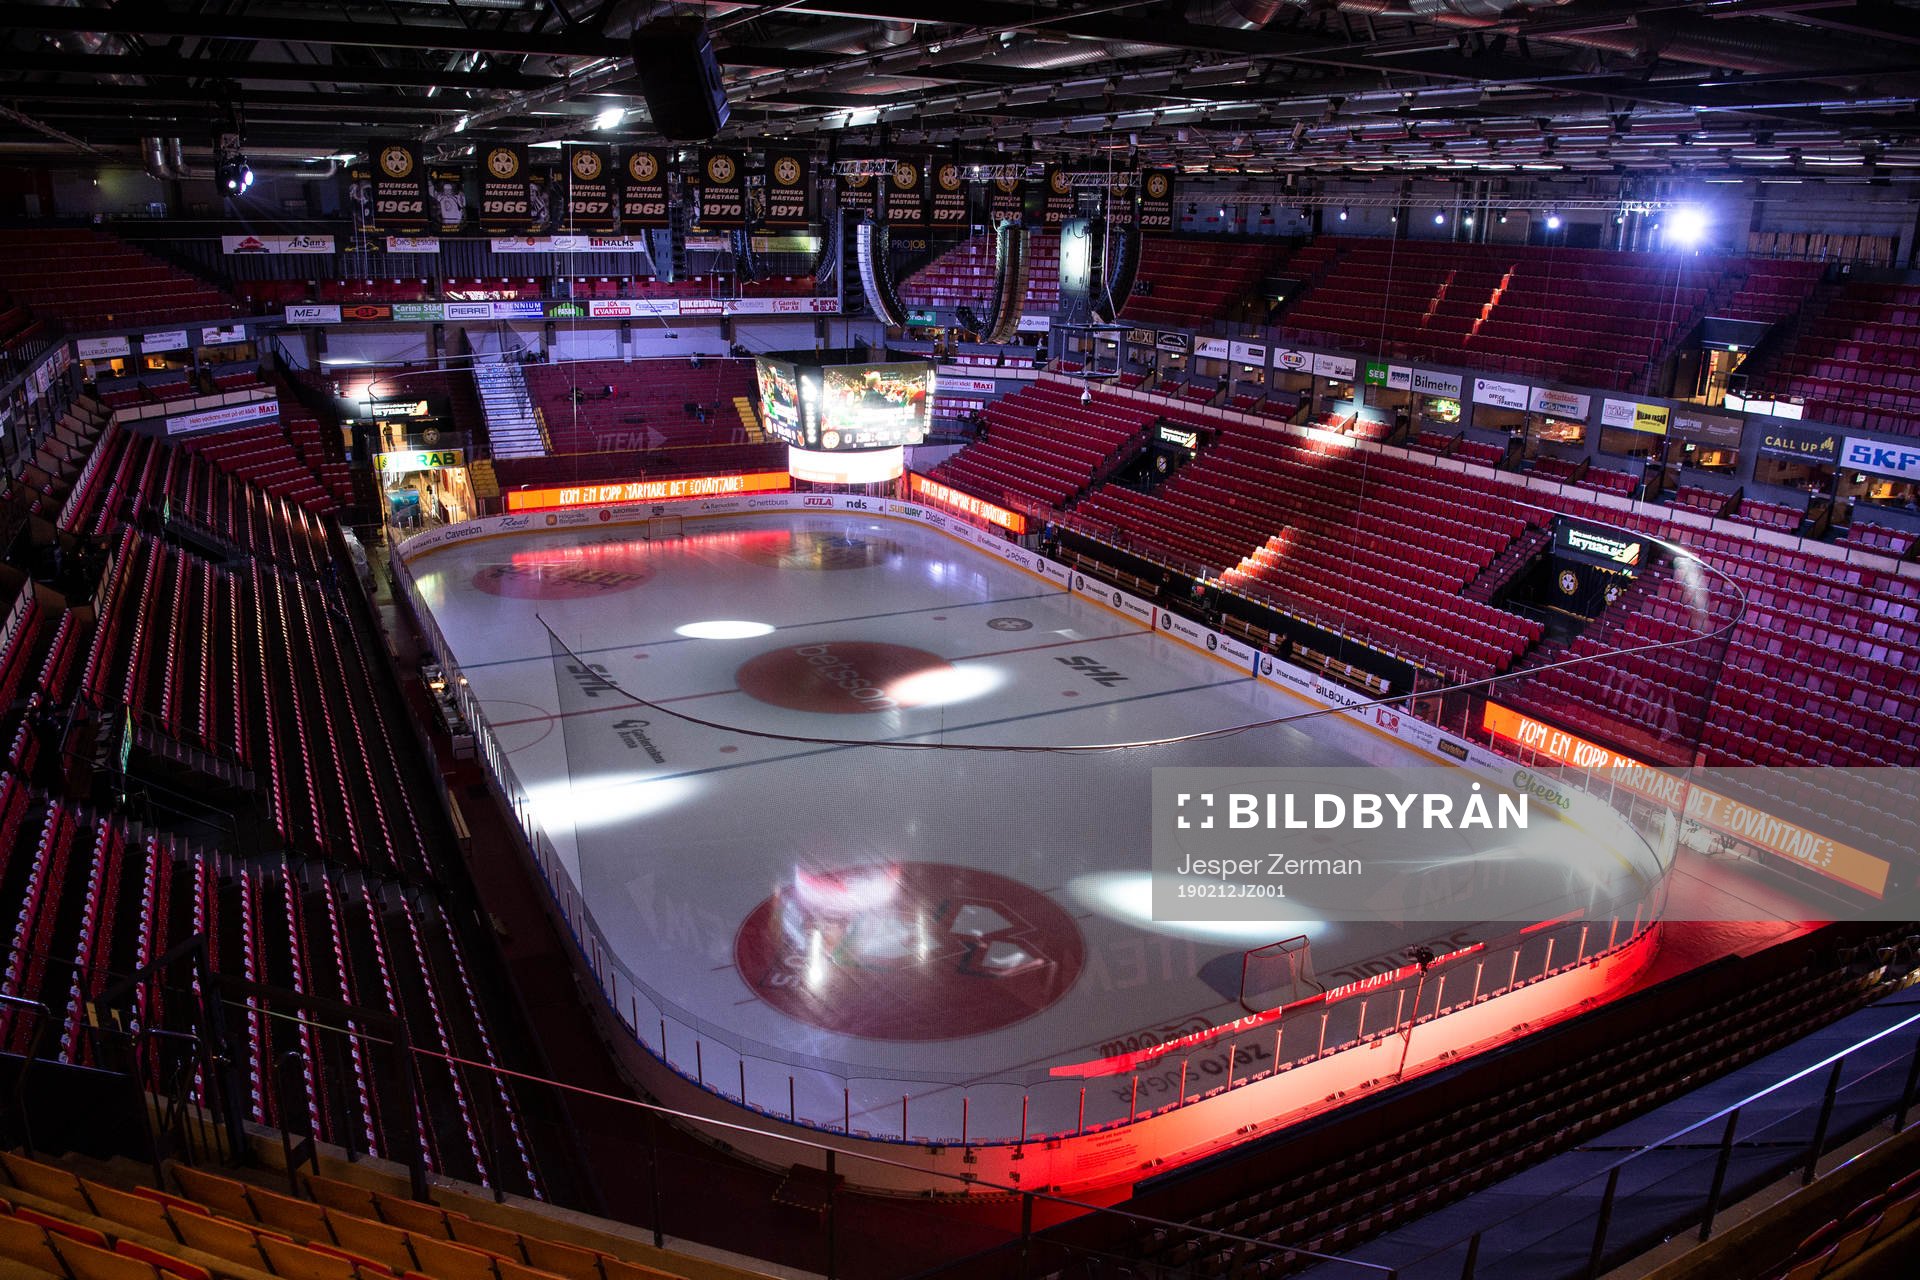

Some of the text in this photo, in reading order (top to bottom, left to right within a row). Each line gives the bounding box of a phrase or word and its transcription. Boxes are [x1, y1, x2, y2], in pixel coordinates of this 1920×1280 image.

[376, 201, 423, 212] 1964
[483, 201, 528, 213] 1966
[567, 202, 609, 213] 1967
[624, 203, 666, 215] 1968
[703, 204, 742, 216] 1970
[770, 205, 804, 217] 1971
[888, 208, 922, 220] 1976
[933, 209, 966, 220] 1977
[1141, 215, 1170, 226] 2012
[294, 309, 321, 318] MEJ
[451, 307, 487, 315] PIERRE
[1128, 331, 1139, 341] XL
[1141, 333, 1153, 343] XL
[1369, 369, 1386, 379] SEB
[1415, 375, 1458, 393] Bilmetro
[596, 432, 644, 452] ITEM
[1764, 436, 1818, 453] CALL UP
[1849, 445, 1920, 471] SKF
[559, 489, 580, 504] KOM
[600, 485, 622, 501] KOPP
[670, 481, 687, 496] DET
[805, 498, 832, 506] JULA
[847, 499, 867, 510] nds
[888, 504, 923, 518] SUBWAY
[925, 511, 946, 527] Dialect
[444, 526, 482, 541] Caverion
[1010, 552, 1031, 566] PÖYRY
[784, 643, 888, 711] betsson
[1053, 656, 1129, 688] SHL
[566, 663, 618, 698] SHL
[607, 731, 628, 749] Arena
[1512, 768, 1571, 810] Cheers
[1517, 719, 1825, 865] KOM EN KOPP NÄRMARE DET OVÄNTADE
